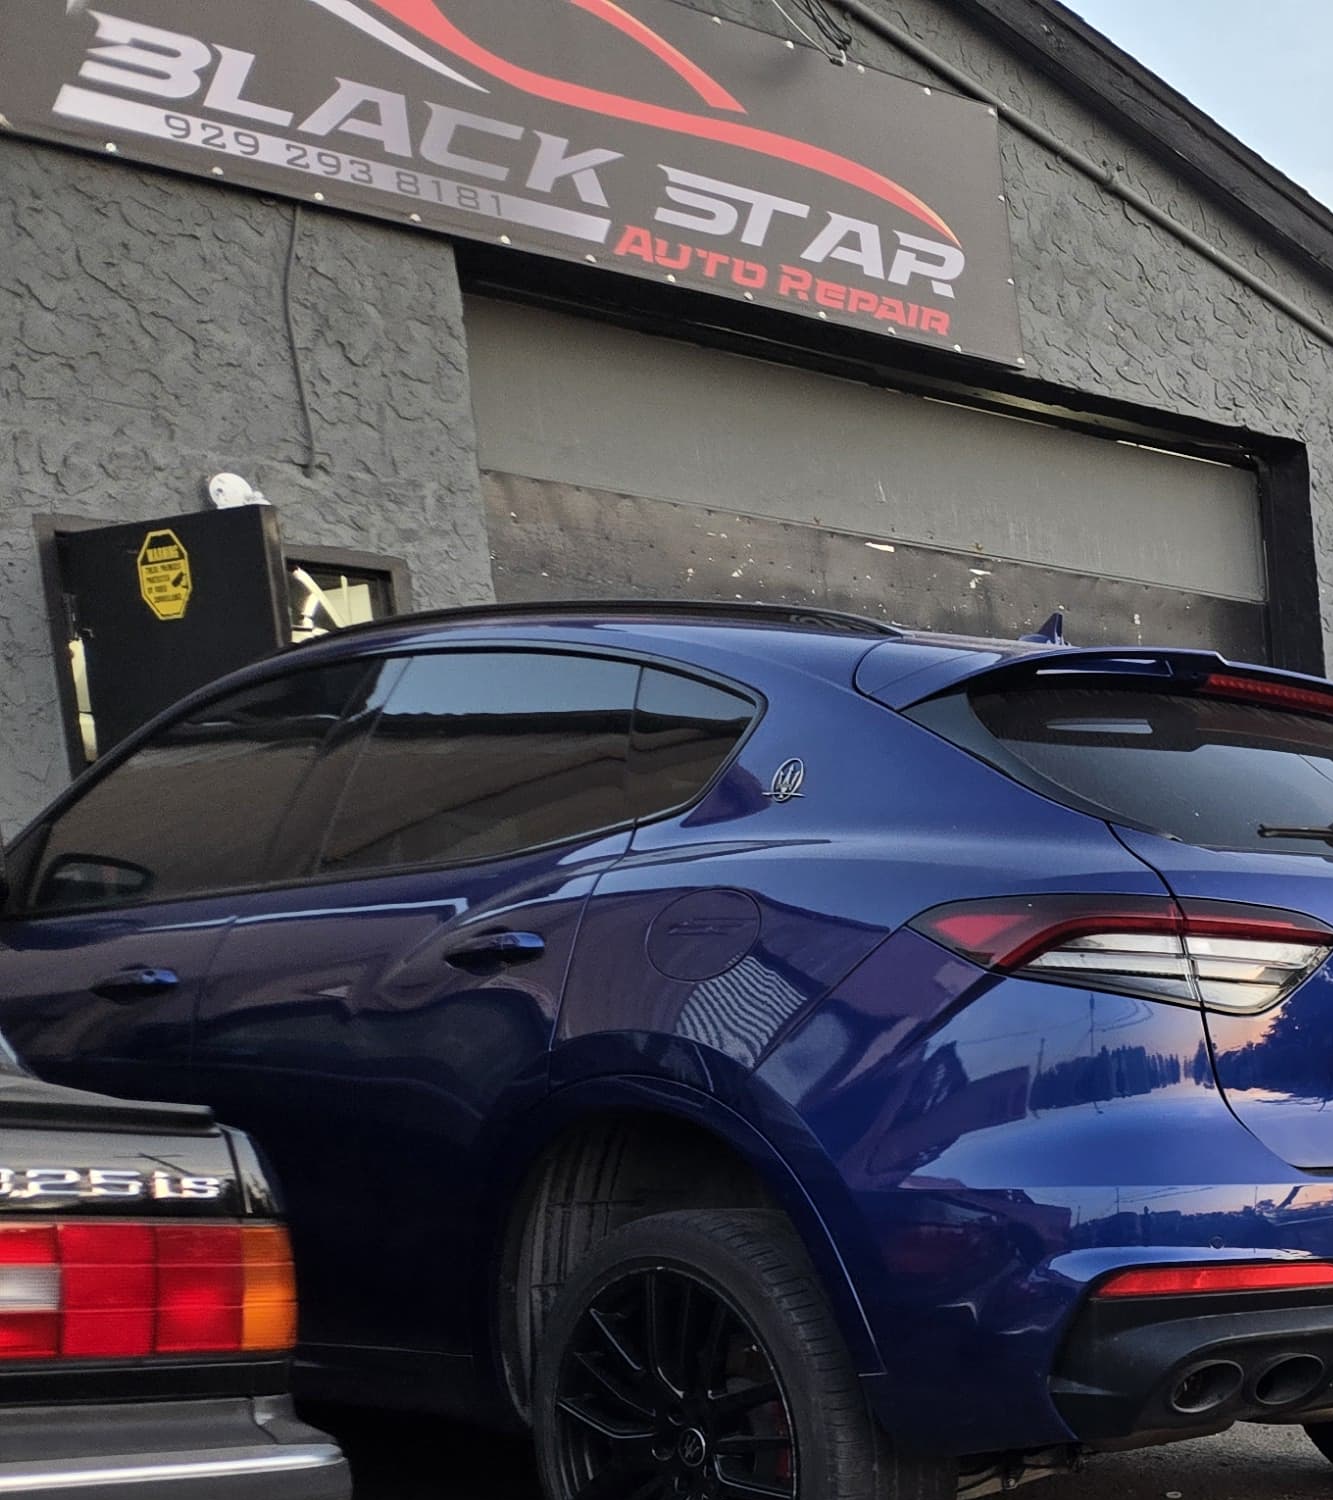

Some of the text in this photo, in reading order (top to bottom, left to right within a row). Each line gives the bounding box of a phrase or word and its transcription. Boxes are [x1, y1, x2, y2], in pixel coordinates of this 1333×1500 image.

[79, 9, 966, 299] BLACK STAR
[163, 113, 503, 217] 929 293 8181
[613, 225, 950, 337] AUTO REPAIR
